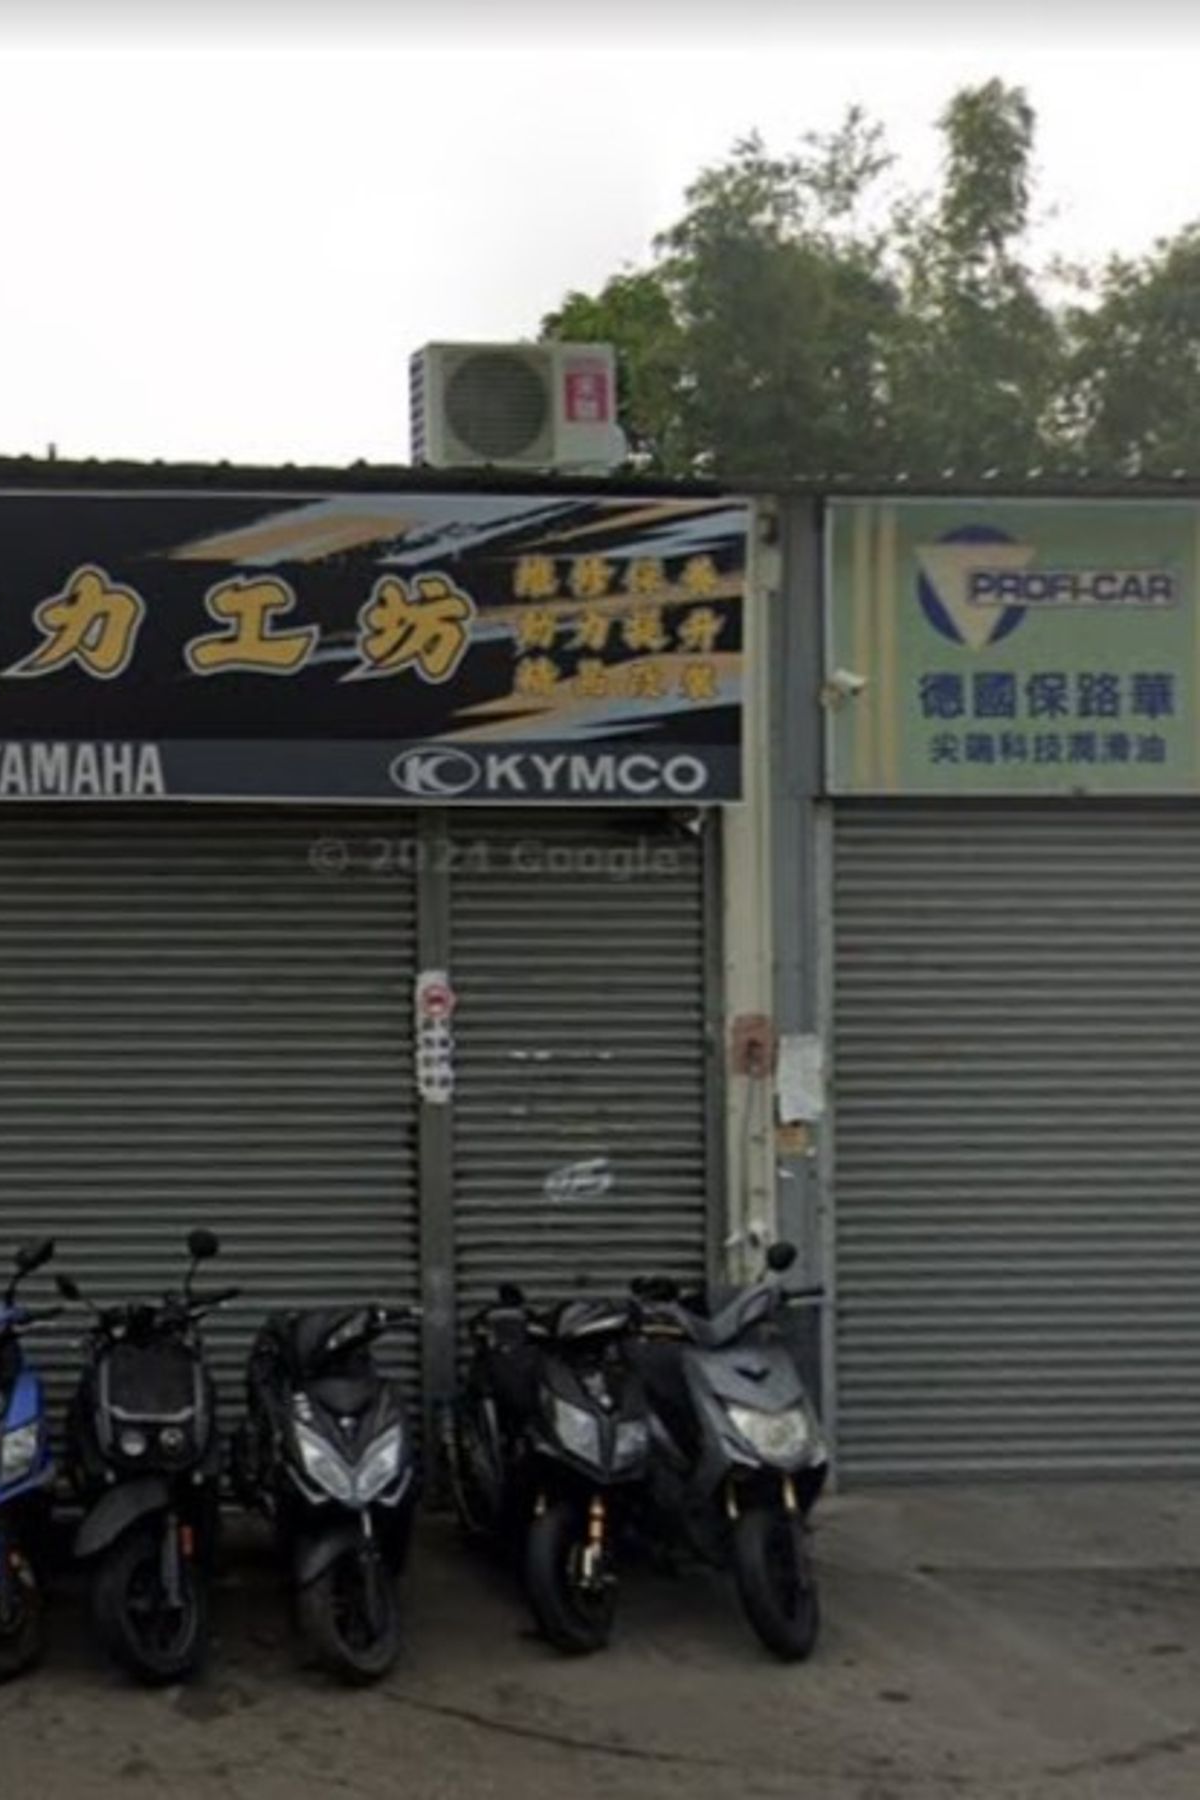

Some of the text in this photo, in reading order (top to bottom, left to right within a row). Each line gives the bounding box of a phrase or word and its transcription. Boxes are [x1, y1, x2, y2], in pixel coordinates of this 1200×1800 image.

[969, 573, 1173, 601] PROFI-CAR
[918, 671, 1175, 720] 德國保路華
[486, 753, 709, 793] KYMCO
